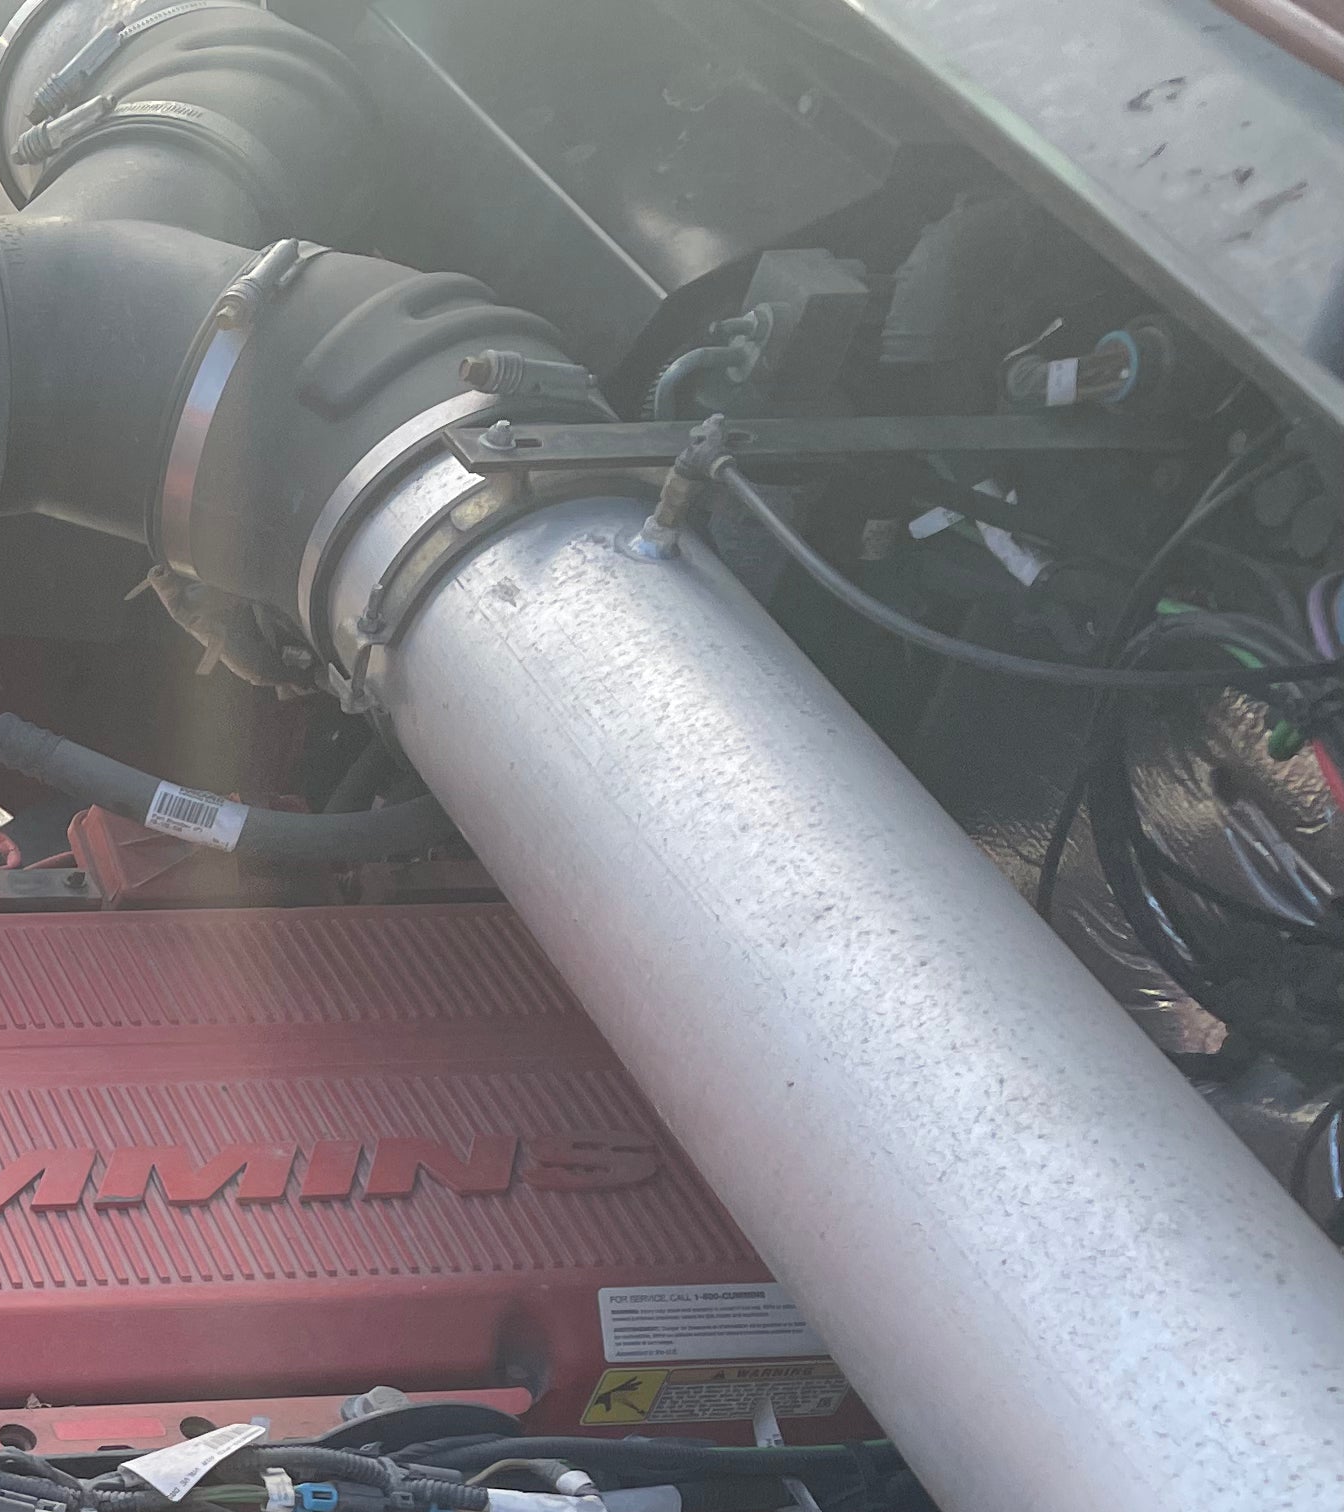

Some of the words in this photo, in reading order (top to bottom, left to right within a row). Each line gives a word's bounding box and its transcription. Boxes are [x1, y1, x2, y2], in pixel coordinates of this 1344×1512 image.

[610, 1296, 627, 1304] FOR
[670, 1293, 692, 1302] CALL
[737, 1367, 812, 1379] WARNING
